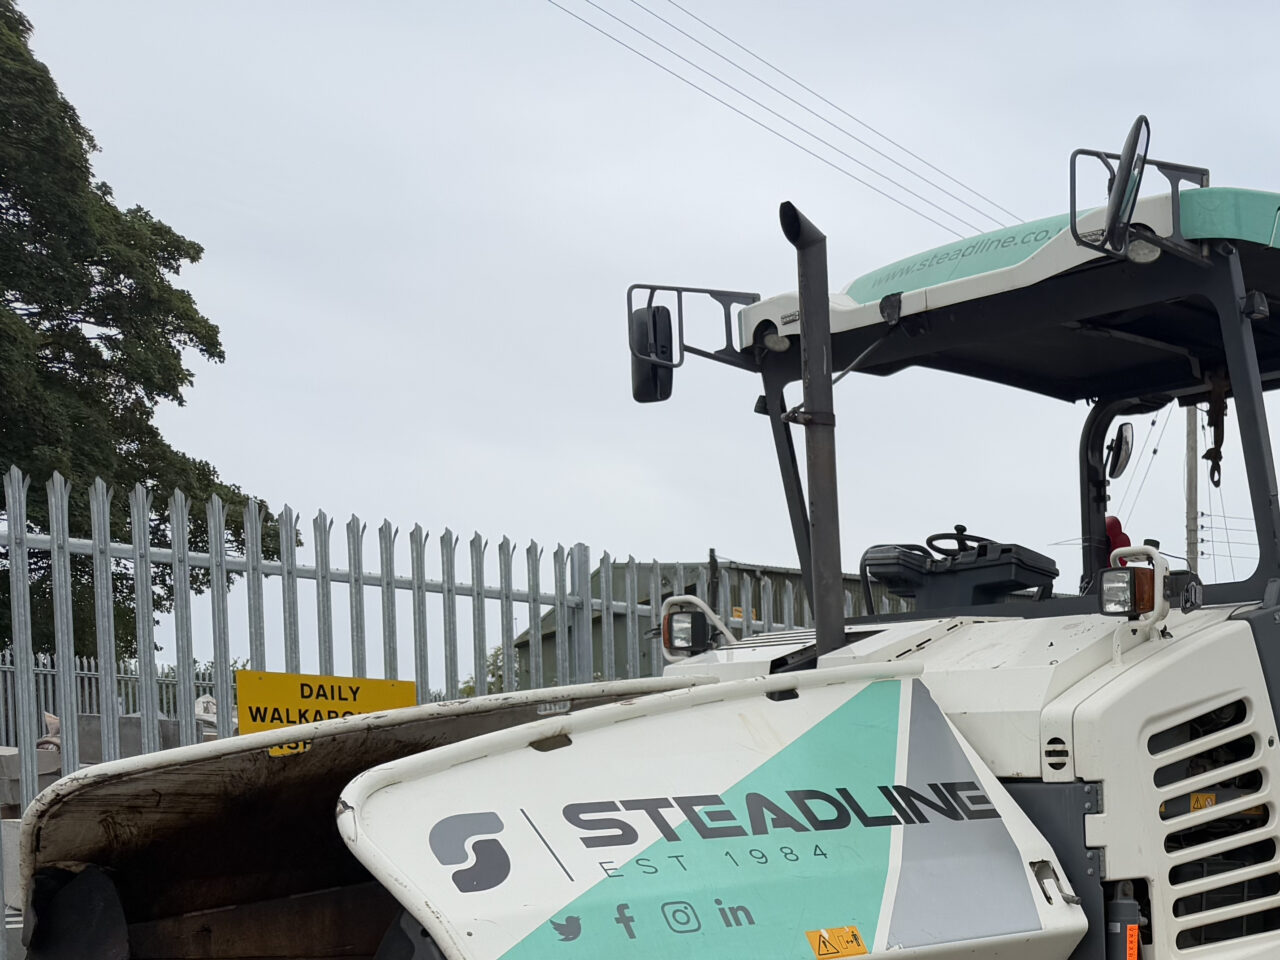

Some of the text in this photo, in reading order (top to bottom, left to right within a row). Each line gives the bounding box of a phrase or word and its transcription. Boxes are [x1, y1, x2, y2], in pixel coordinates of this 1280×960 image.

[872, 228, 1062, 288] www.steadline.co.
[300, 683, 360, 702] DAILY
[248, 706, 362, 724] WALKA
[562, 781, 1002, 848] STEADLINE
[599, 844, 828, 878] EST 1984
